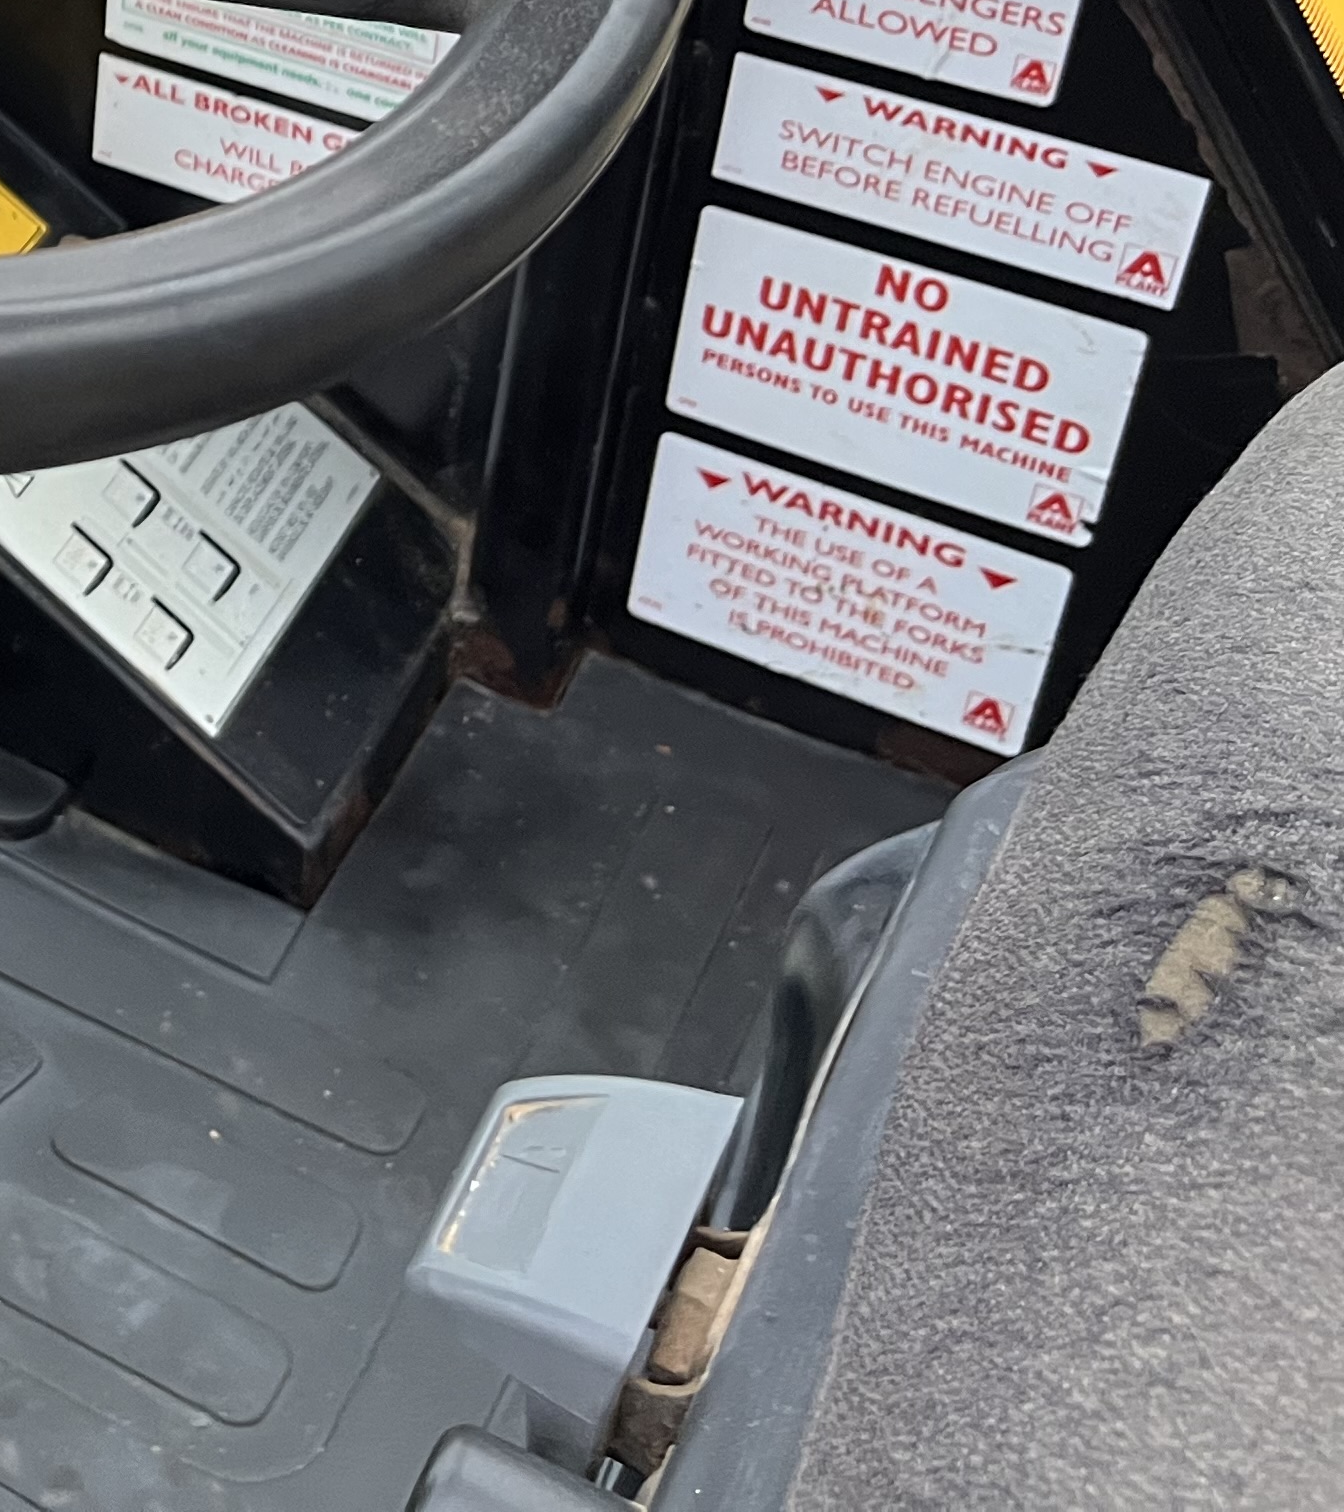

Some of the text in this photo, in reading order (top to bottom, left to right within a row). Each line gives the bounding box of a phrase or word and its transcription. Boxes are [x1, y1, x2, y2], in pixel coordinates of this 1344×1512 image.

[147, 4, 181, 22] CLEAN
[185, 14, 249, 41] CONDITION
[268, 38, 326, 65] CLEANING
[181, 36, 209, 52] your
[212, 46, 279, 75] equipment
[255, 18, 276, 35] THE
[279, 26, 333, 52] MACHINE
[132, 74, 185, 105] ALL
[194, 92, 313, 145] BROKEN
[863, 95, 1069, 171] WARNING
[219, 138, 281, 173] WILL
[778, 118, 1133, 234] SWITCH ENGINE OFF
[779, 150, 1114, 263] BEFORE REFUELLING
[874, 263, 949, 313] NO
[701, 303, 1092, 455] UNAUTHORISED
[759, 275, 1051, 393] UNTRAINED
[700, 348, 1073, 484] PERSONS TO USE THIS MACHINE
[742, 471, 967, 569] WARNING
[754, 514, 939, 596] THE USE OF A
[686, 543, 986, 665] FITTED TO THE FORKS
[694, 518, 987, 639] WORKING PLATFORM
[709, 577, 951, 679] OF THIS MACHINE
[758, 620, 916, 690] PROHIBITED
